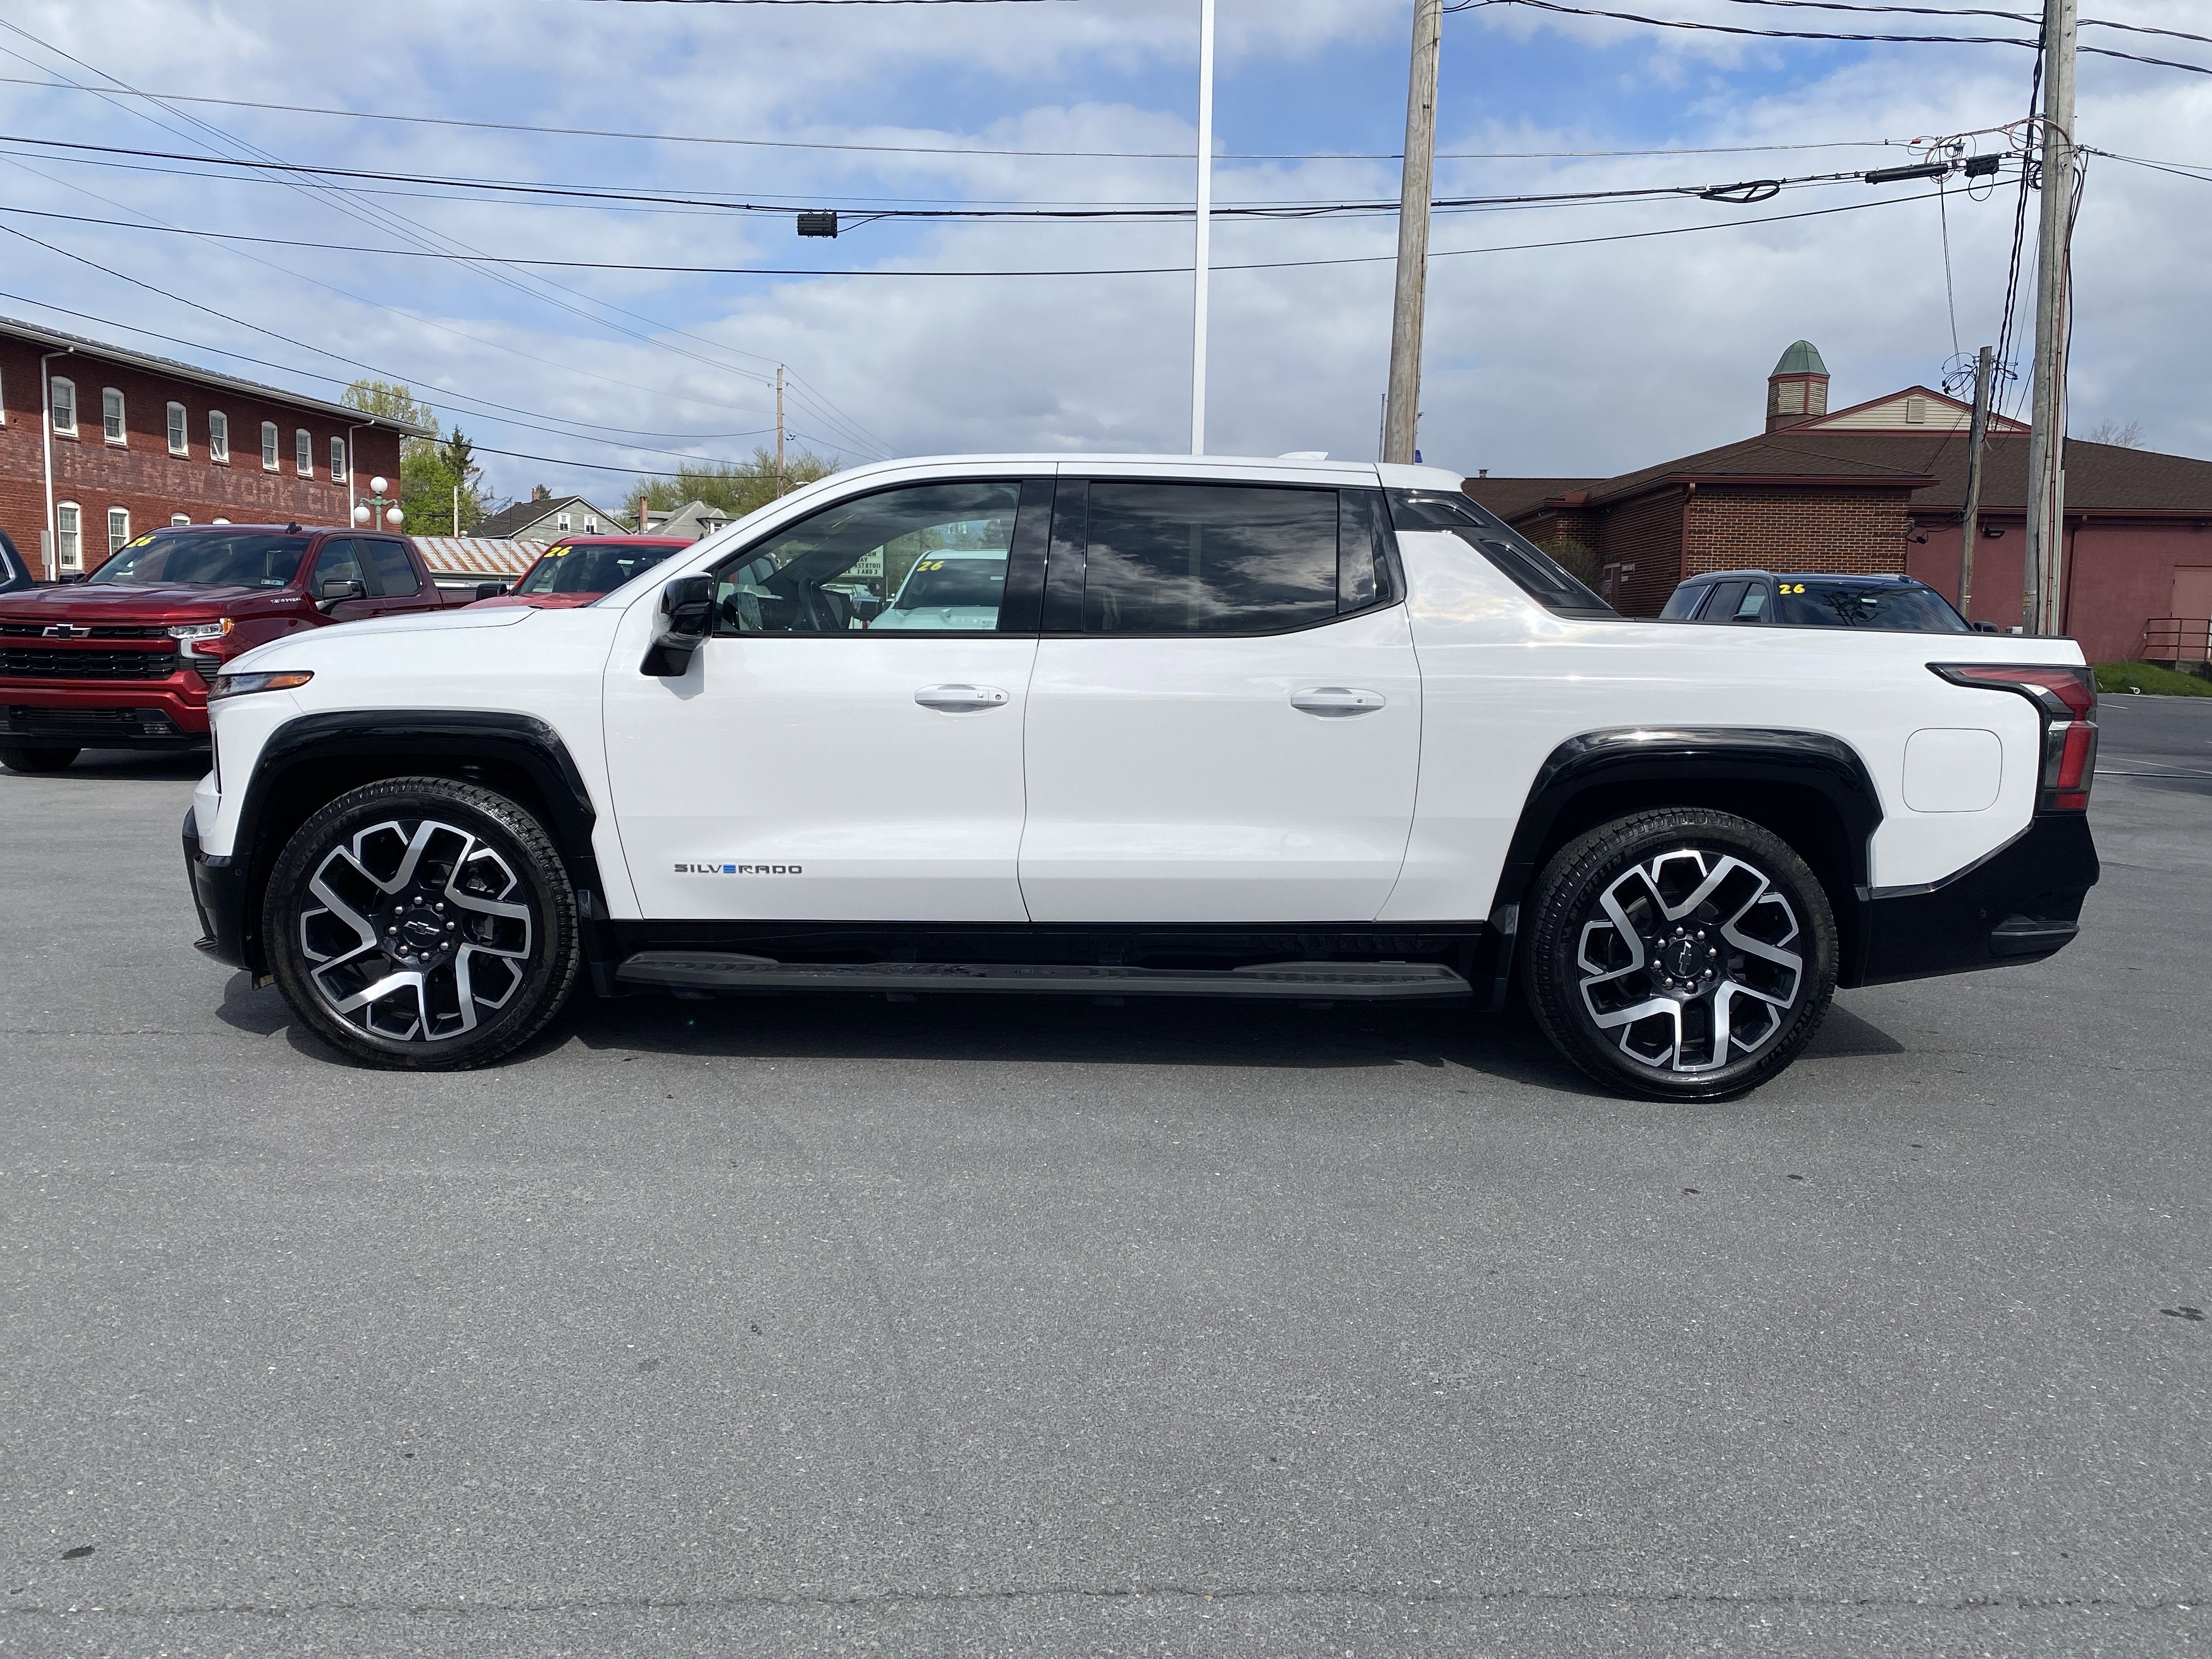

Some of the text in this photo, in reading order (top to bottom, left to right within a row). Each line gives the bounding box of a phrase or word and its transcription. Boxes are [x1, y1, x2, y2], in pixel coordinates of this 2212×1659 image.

[543, 545, 573, 558] 26
[916, 560, 945, 572] 26
[1779, 584, 1805, 595] 26
[1631, 837, 1661, 852] PRIMACY
[674, 864, 803, 874] SILVERADO
[1569, 854, 1622, 922] MICHELIN
[1760, 1002, 1814, 1068] MICHELIN
